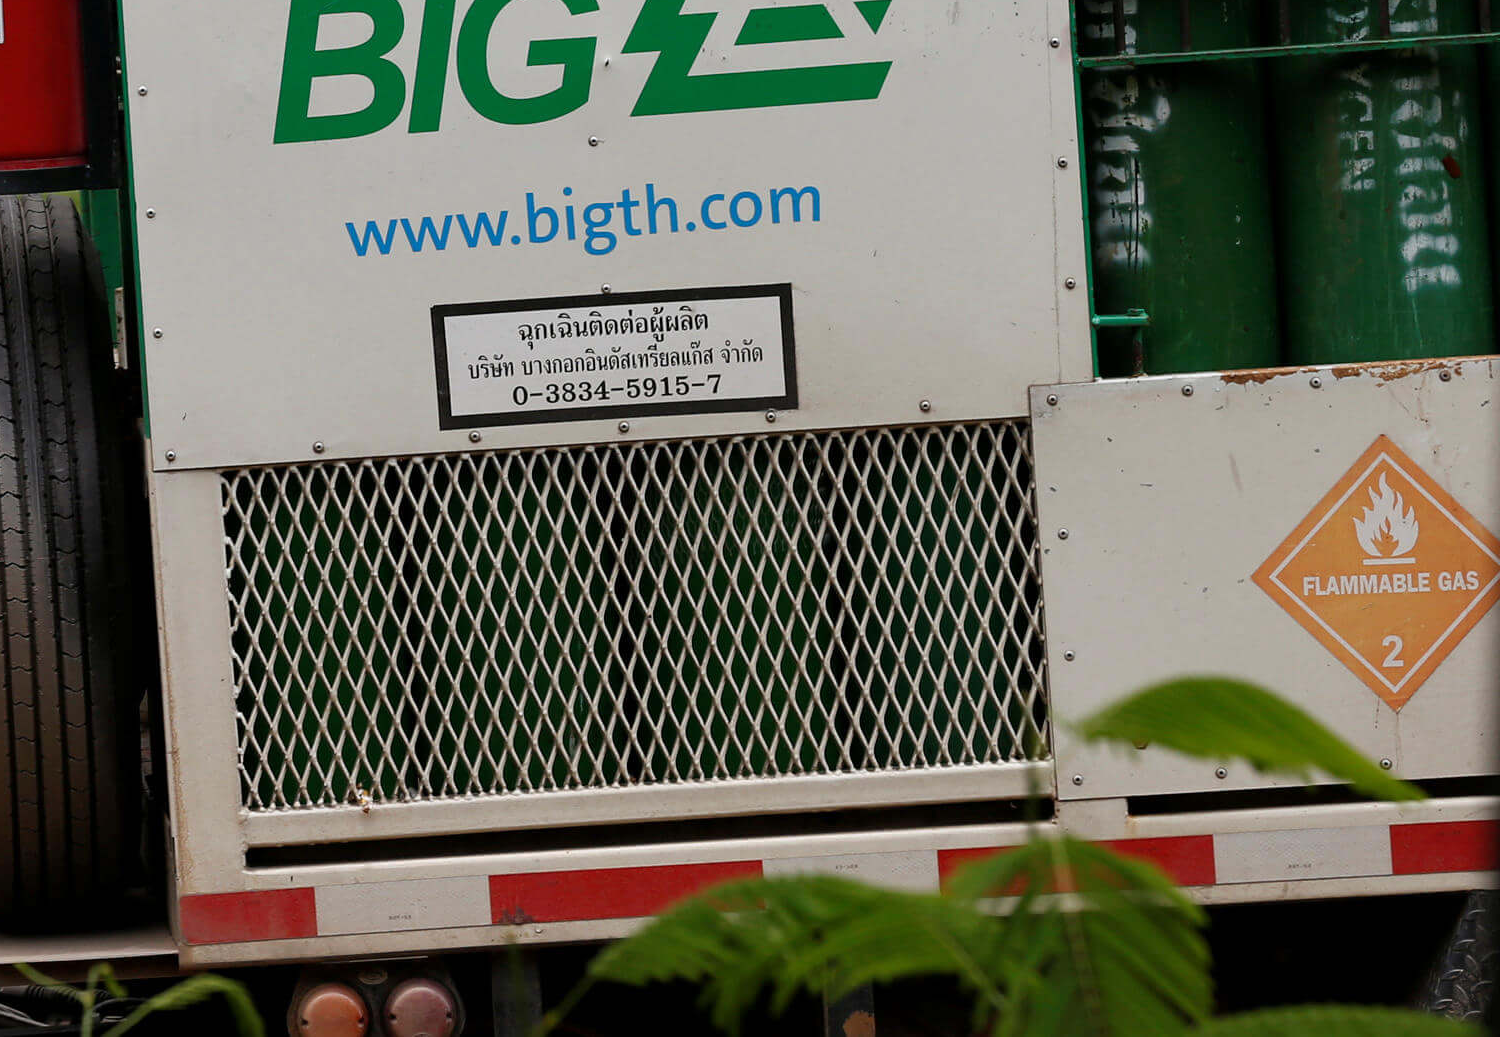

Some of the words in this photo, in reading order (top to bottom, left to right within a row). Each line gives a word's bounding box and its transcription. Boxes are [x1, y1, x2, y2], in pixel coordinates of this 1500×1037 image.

[346, 184, 820, 256] www.bigth.com
[518, 305, 709, 350] ฉุกเฉินติดต่อผู้ผลิต
[468, 353, 514, 380] บริษัท
[521, 340, 714, 376] บางกอกอินดัสเทรียลแก๊ส
[720, 338, 764, 365] จำกัด
[512, 373, 722, 405] 0-3834-5915-7
[1303, 571, 1431, 597] FLAMMABLE
[1438, 570, 1479, 592] GAS
[1381, 635, 1405, 669] 2
